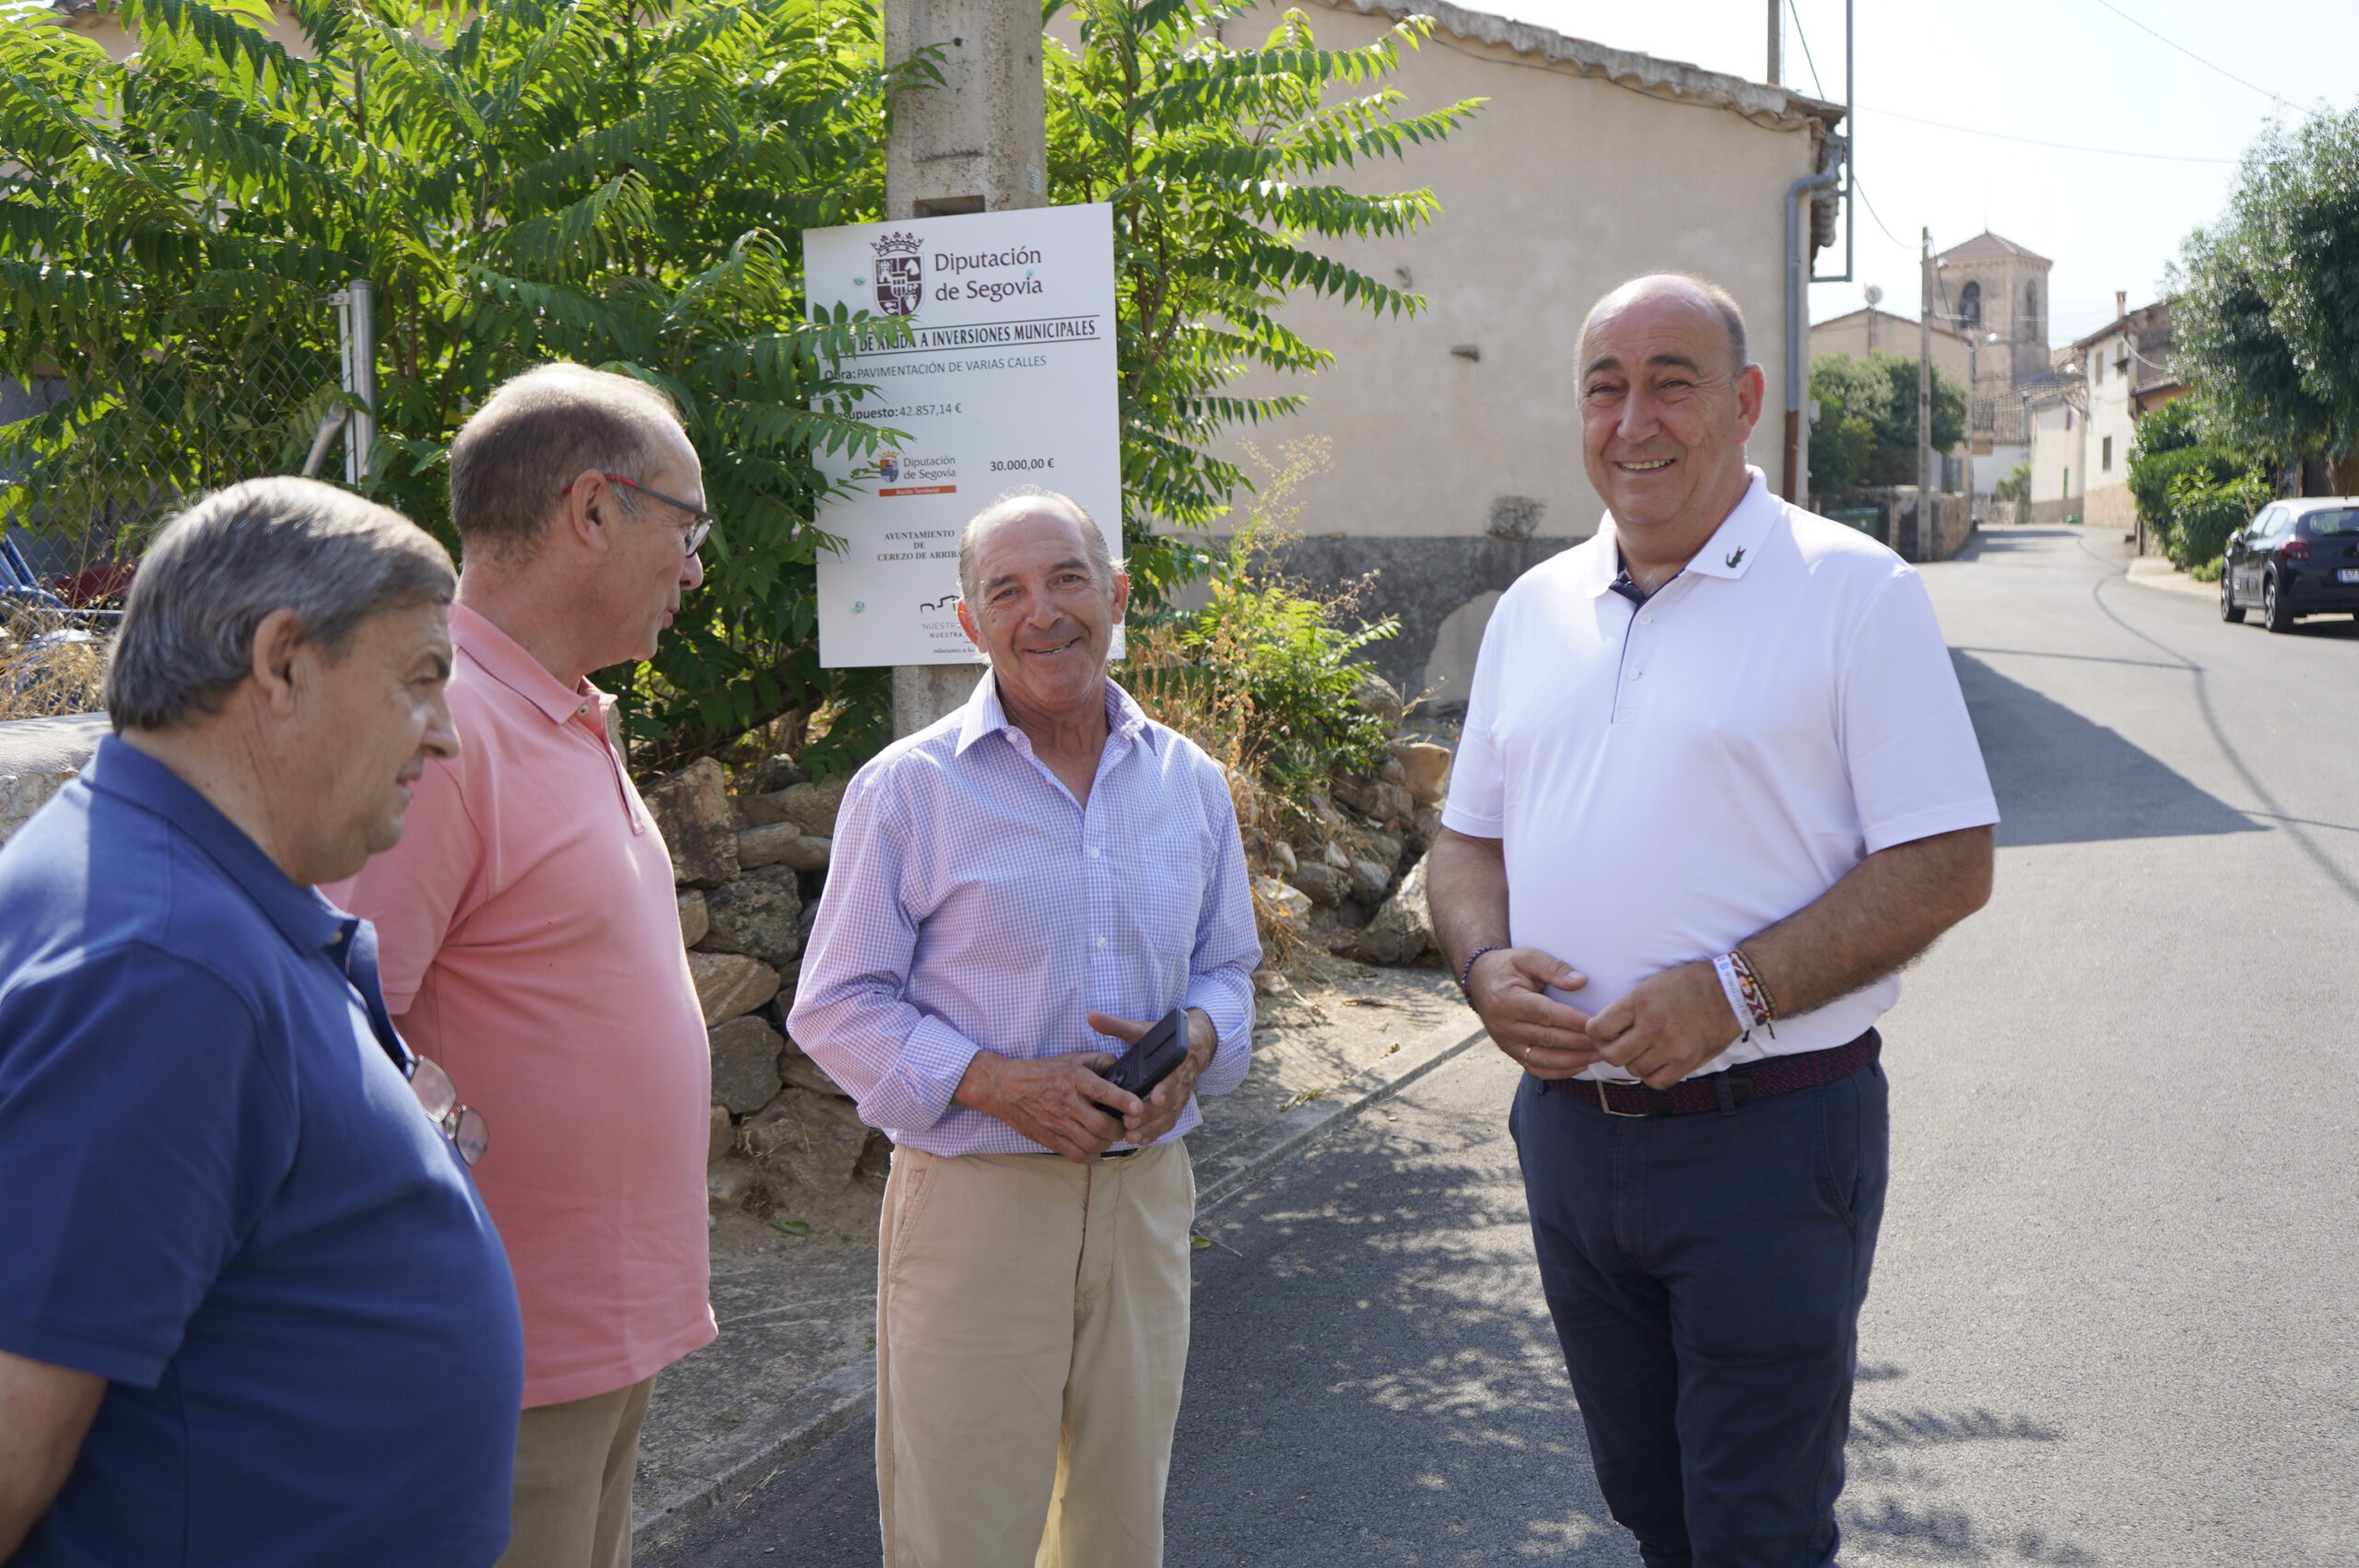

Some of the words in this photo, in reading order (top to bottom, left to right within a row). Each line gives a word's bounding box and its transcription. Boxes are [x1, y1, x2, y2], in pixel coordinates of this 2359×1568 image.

[934, 245, 1042, 275] Diputación
[935, 283, 960, 301] de
[967, 276, 1043, 302] Segovia
[921, 332, 929, 347] A
[933, 326, 1011, 346] INVERSIONES
[1014, 320, 1096, 341] MUNICIPALES
[857, 361, 945, 379] PAVIMENTACIÓN
[948, 361, 962, 372] DE
[966, 358, 1005, 370] VARIAS
[1007, 355, 1047, 369] CALLES
[899, 404, 953, 417] 42.857,14
[955, 403, 962, 414] €
[903, 455, 956, 469] Diputación
[990, 458, 1045, 472] 30.000,00
[1047, 457, 1055, 468] €
[904, 470, 916, 480] de
[919, 468, 957, 481] Segovia
[884, 530, 956, 541] AYUNTAMIENTO
[913, 542, 926, 550] DE
[877, 552, 914, 562] CEREZO
[915, 552, 927, 560] DE
[929, 550, 959, 559] ARRIB
